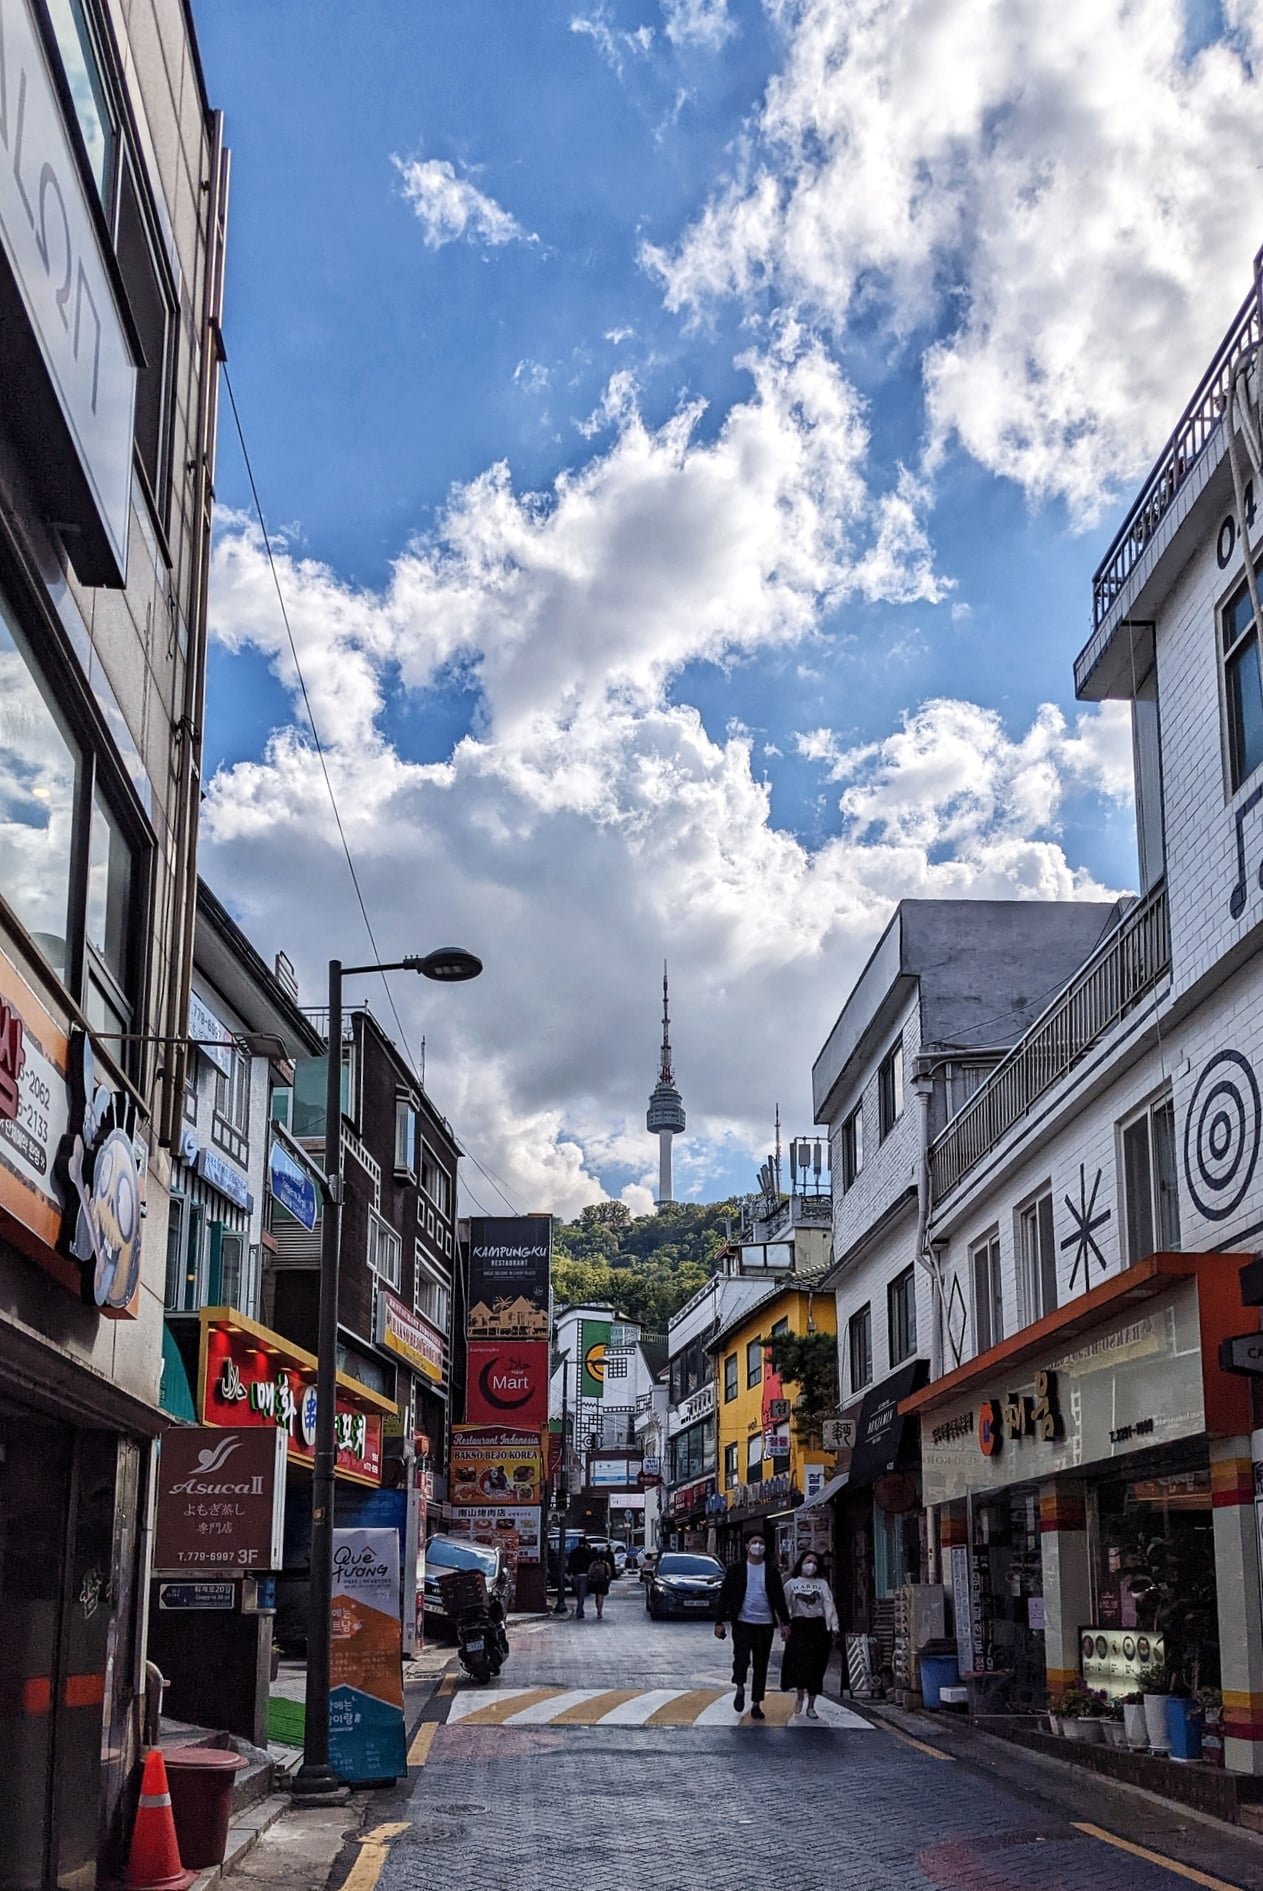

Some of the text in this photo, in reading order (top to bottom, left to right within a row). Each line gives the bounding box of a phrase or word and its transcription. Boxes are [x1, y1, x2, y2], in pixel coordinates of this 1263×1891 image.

[473, 1246, 547, 1258] KAMPUNGKU
[1248, 1347, 1263, 1359] C
[493, 1375, 528, 1389] Mart
[453, 1434, 539, 1445] Restaurant Indonesia
[454, 1451, 537, 1459] BAKSO BEJO KOREA
[183, 1503, 246, 1516] よもぎ蒸し
[178, 1550, 258, 1564] T.779-6997 3F
